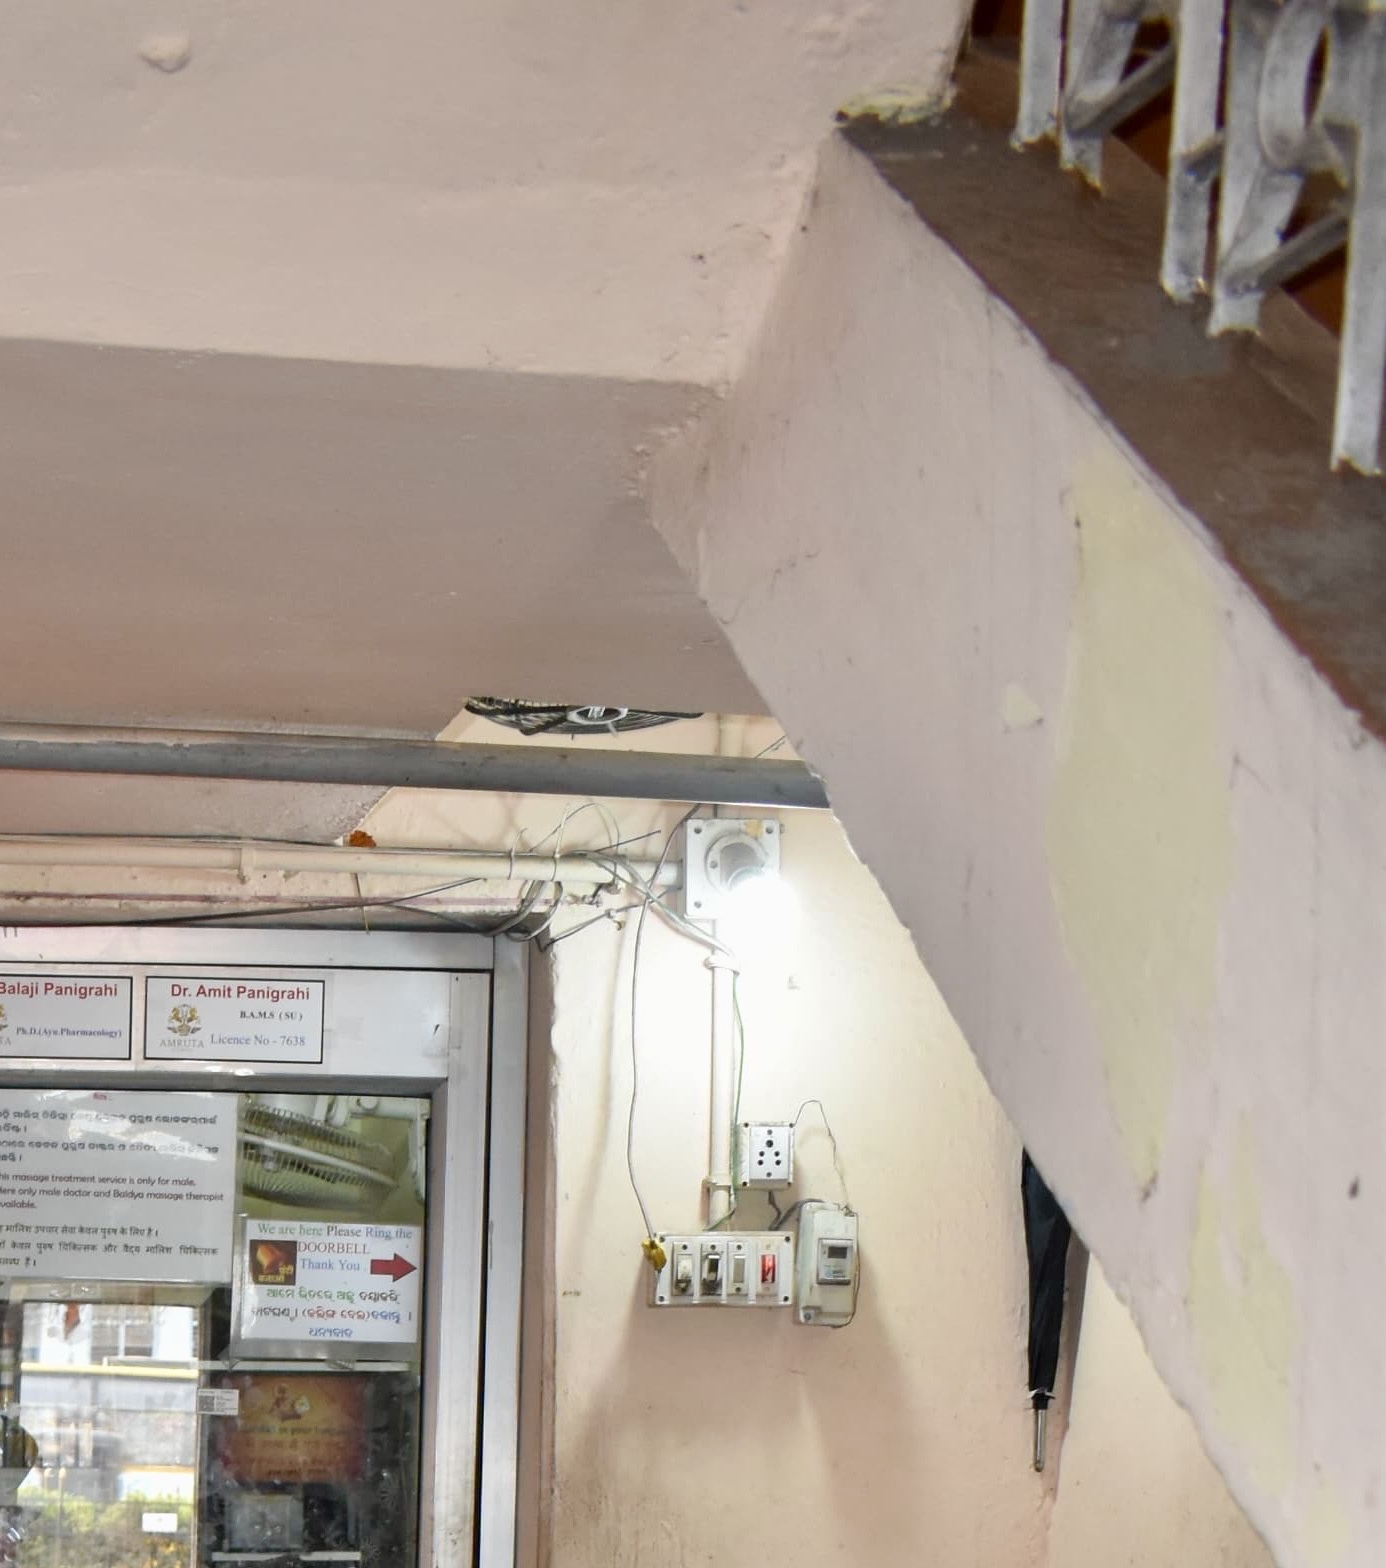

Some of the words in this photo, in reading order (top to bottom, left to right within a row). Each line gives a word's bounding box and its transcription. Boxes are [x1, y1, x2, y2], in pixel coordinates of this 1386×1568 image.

[43, 981, 119, 1000] Panigrahi
[170, 983, 193, 998] Dr.
[196, 983, 233, 999] Amit
[236, 985, 311, 1003] Panigrahi
[210, 1033, 252, 1046] Licence
[253, 1034, 270, 1046] No
[279, 1034, 306, 1046] 7638
[11, 1173, 49, 1183] massage
[51, 1173, 95, 1183] treatment
[97, 1175, 126, 1185] service
[128, 1176, 136, 1185] is
[136, 1176, 156, 1186] only
[157, 1176, 169, 1186] for
[17, 1186, 36, 1197] only
[38, 1187, 61, 1197] male
[62, 1187, 91, 1197] doctor
[93, 1188, 111, 1198] and
[146, 1190, 183, 1201] massage
[185, 1190, 223, 1202] therapist
[257, 1222, 276, 1235] We
[277, 1224, 296, 1236] are
[298, 1224, 323, 1238] here
[326, 1224, 362, 1238] Please
[365, 1226, 392, 1241] Ring
[394, 1227, 413, 1239] the
[297, 1240, 371, 1255] DOORBELL
[300, 1257, 334, 1270] Thank
[338, 1258, 361, 1271] You
